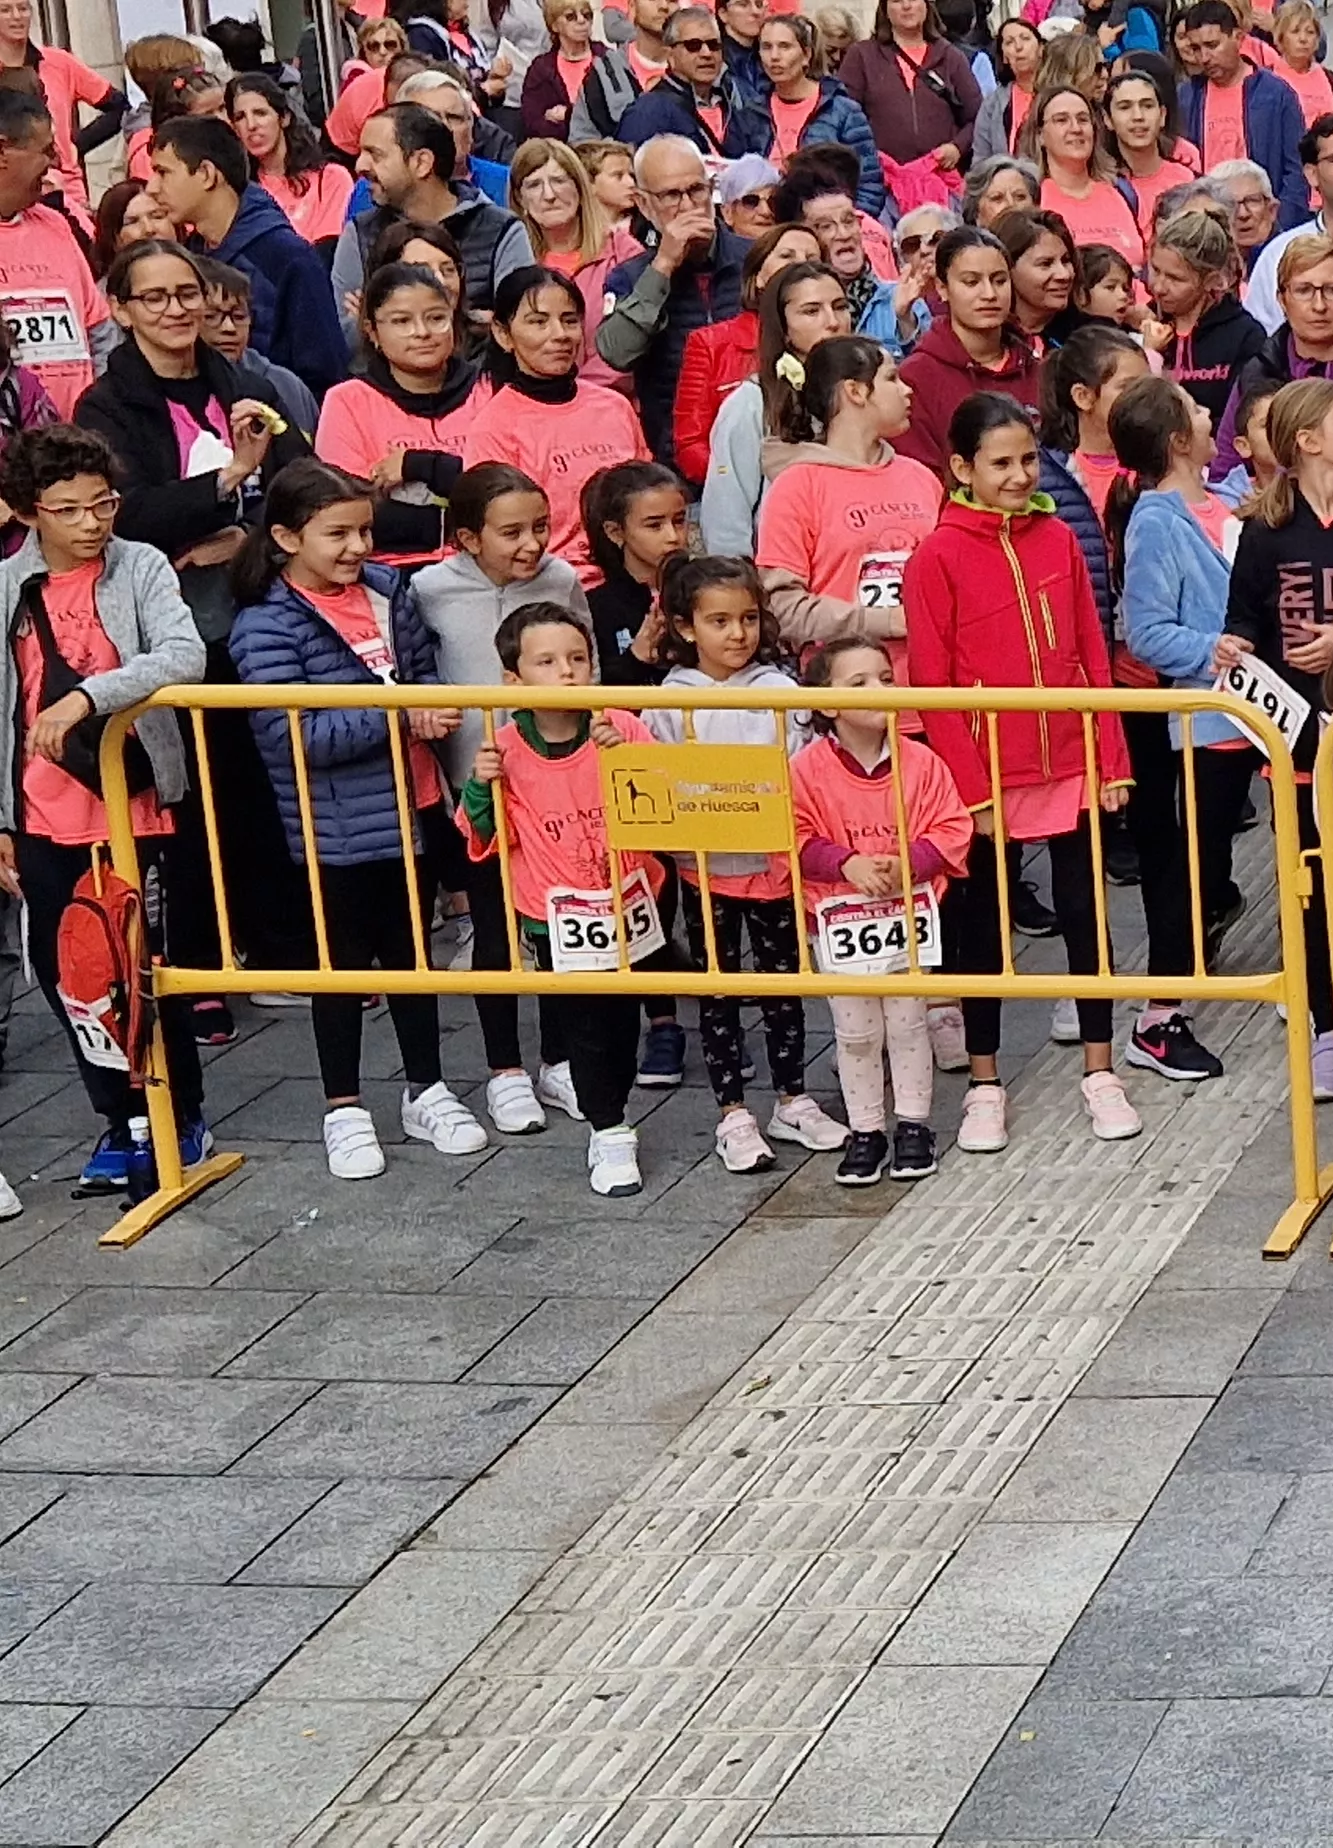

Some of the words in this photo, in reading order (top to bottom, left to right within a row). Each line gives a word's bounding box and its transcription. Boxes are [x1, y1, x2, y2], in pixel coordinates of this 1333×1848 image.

[4, 314, 75, 343] 2871
[1276, 561, 1315, 662] VERY
[1228, 663, 1292, 734] 1619
[677, 800, 697, 813] de
[700, 799, 761, 813] Huesca
